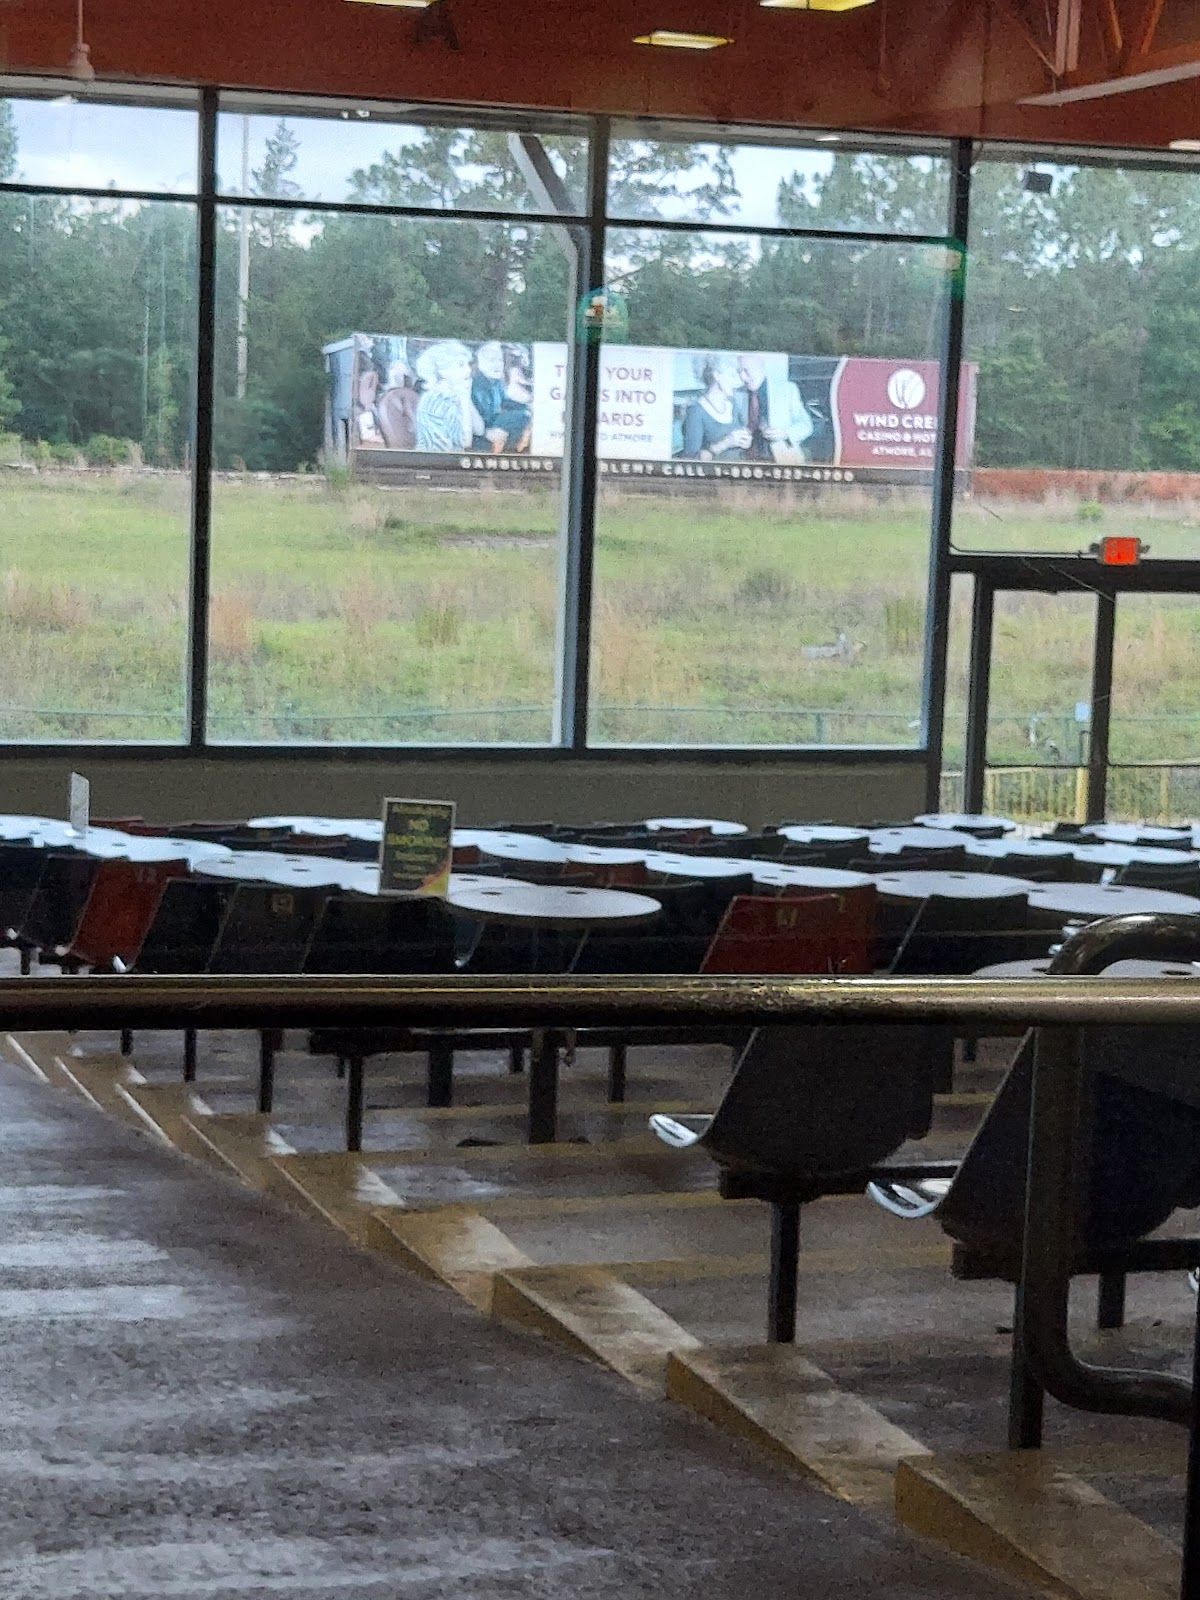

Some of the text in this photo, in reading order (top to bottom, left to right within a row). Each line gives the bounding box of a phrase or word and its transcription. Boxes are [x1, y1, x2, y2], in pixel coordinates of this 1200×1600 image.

[606, 367, 653, 381] YOUR
[616, 390, 657, 404] INTO
[854, 414, 938, 429] WIND CRE
[857, 431, 901, 442] CASINO
[913, 433, 937, 443] HOT
[460, 456, 554, 471] GAMBLING
[600, 461, 654, 475] BLEM?
[662, 463, 705, 477] CALL
